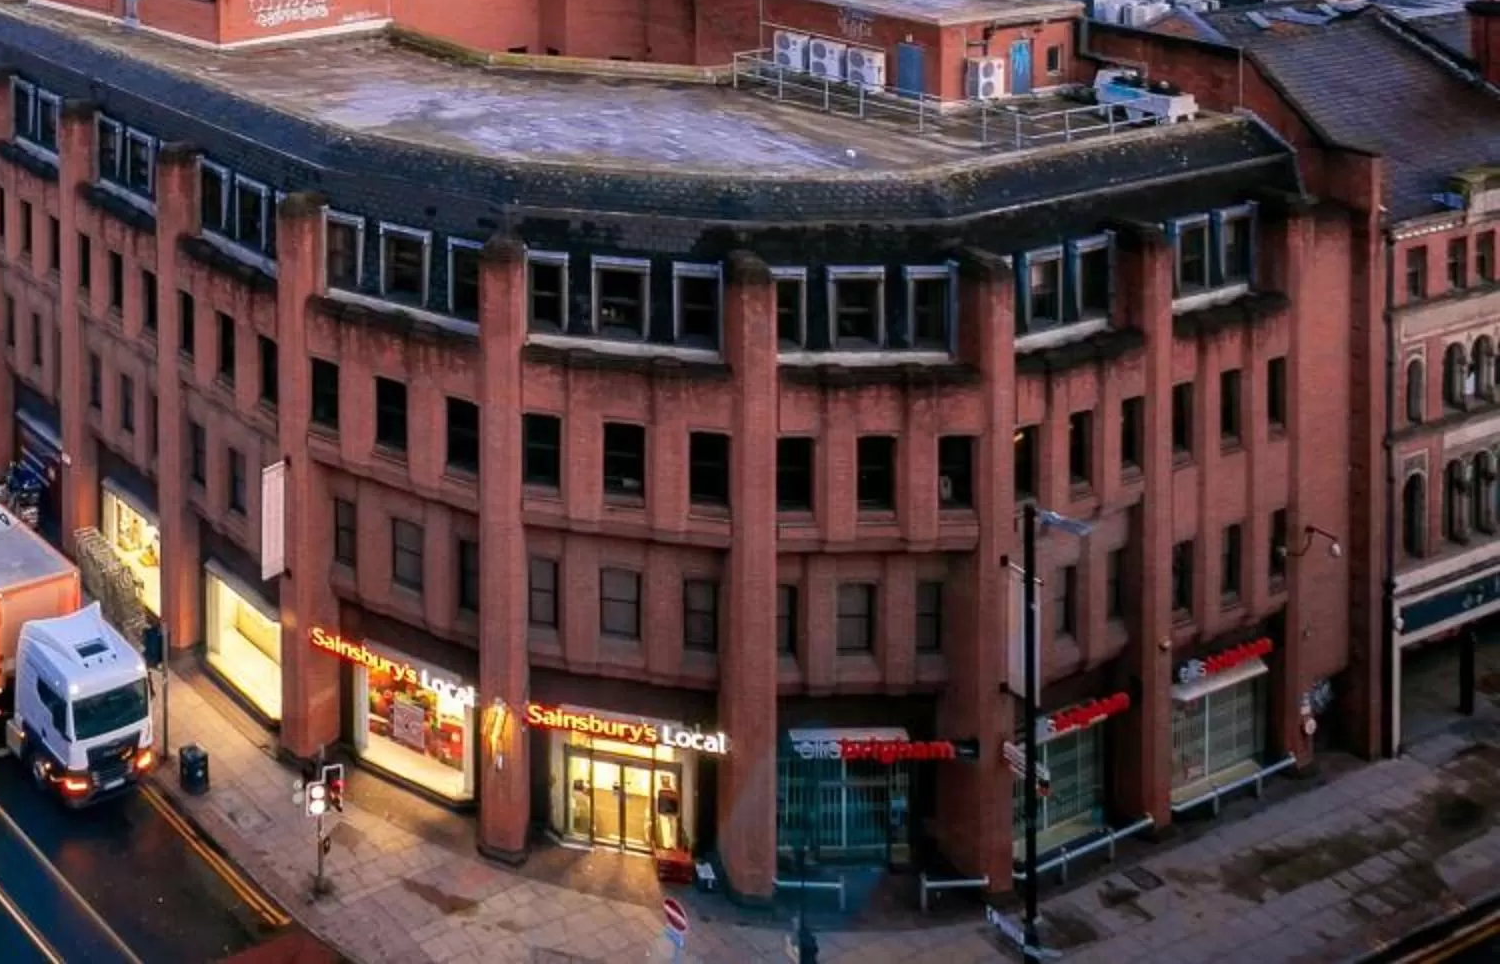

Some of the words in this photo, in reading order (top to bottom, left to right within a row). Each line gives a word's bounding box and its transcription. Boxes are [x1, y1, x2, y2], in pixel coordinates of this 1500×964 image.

[311, 627, 417, 683] Sainsbury's
[419, 669, 475, 708] Local
[527, 704, 657, 742] Sainsbury's
[662, 725, 726, 754] Local
